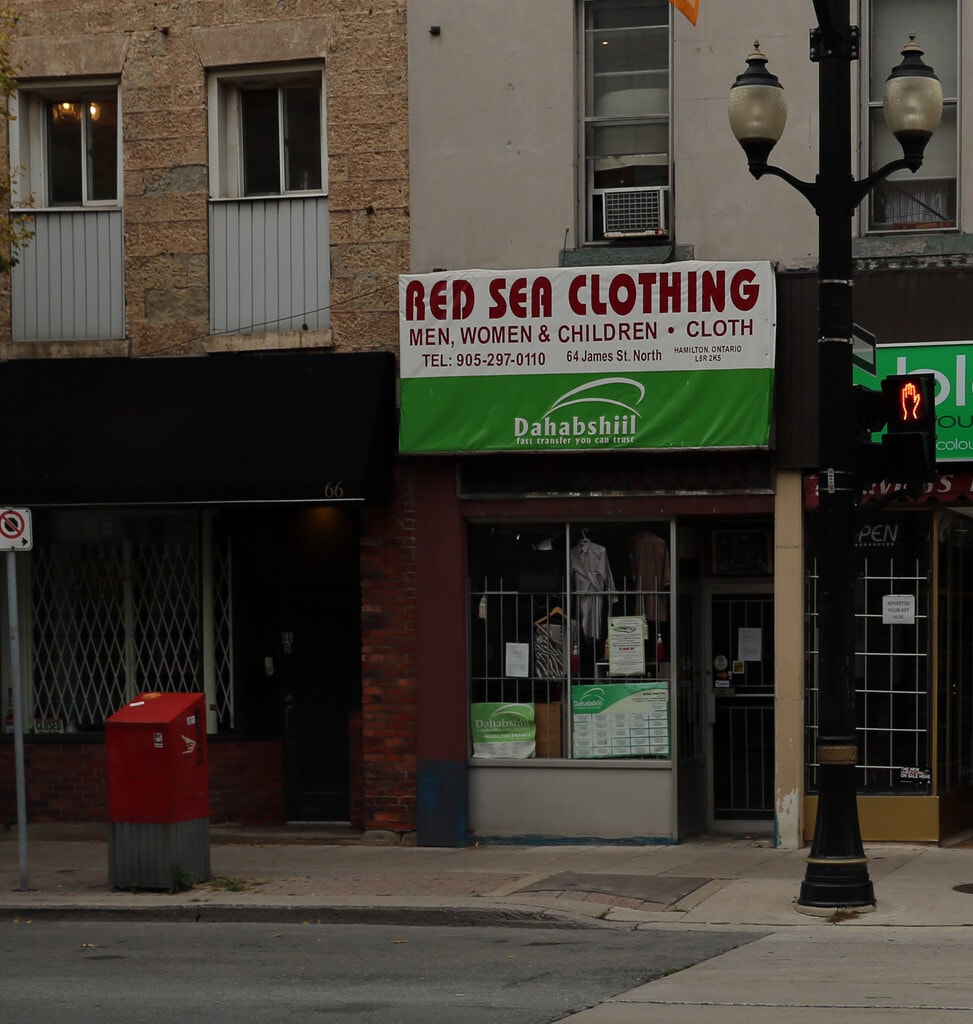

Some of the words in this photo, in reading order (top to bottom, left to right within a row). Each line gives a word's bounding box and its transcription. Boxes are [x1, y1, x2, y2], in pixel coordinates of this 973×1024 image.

[405, 279, 475, 321] RED
[488, 276, 553, 319] SEA
[568, 268, 760, 316] CLOTHING
[409, 327, 455, 348] MEN,
[460, 325, 532, 345] WOMEN
[538, 324, 551, 343] &
[557, 321, 657, 343] CHILDREN
[686, 318, 753, 337] CLOTH
[422, 353, 452, 367] TEL:
[456, 352, 546, 367] 905-297-0110
[566, 350, 579, 362] 64
[582, 349, 613, 362] James
[616, 349, 631, 362] St.
[633, 349, 662, 361] North
[711, 345, 742, 353] ONTARIO
[514, 415, 637, 437] Dahabshiil
[516, 436, 533, 445] fast
[536, 436, 572, 445] transfer
[575, 437, 592, 446] you
[613, 435, 635, 444] trust
[324, 481, 345, 498] 66
[856, 523, 899, 542] PEN
[36, 720, 62, 731] CLOSED
